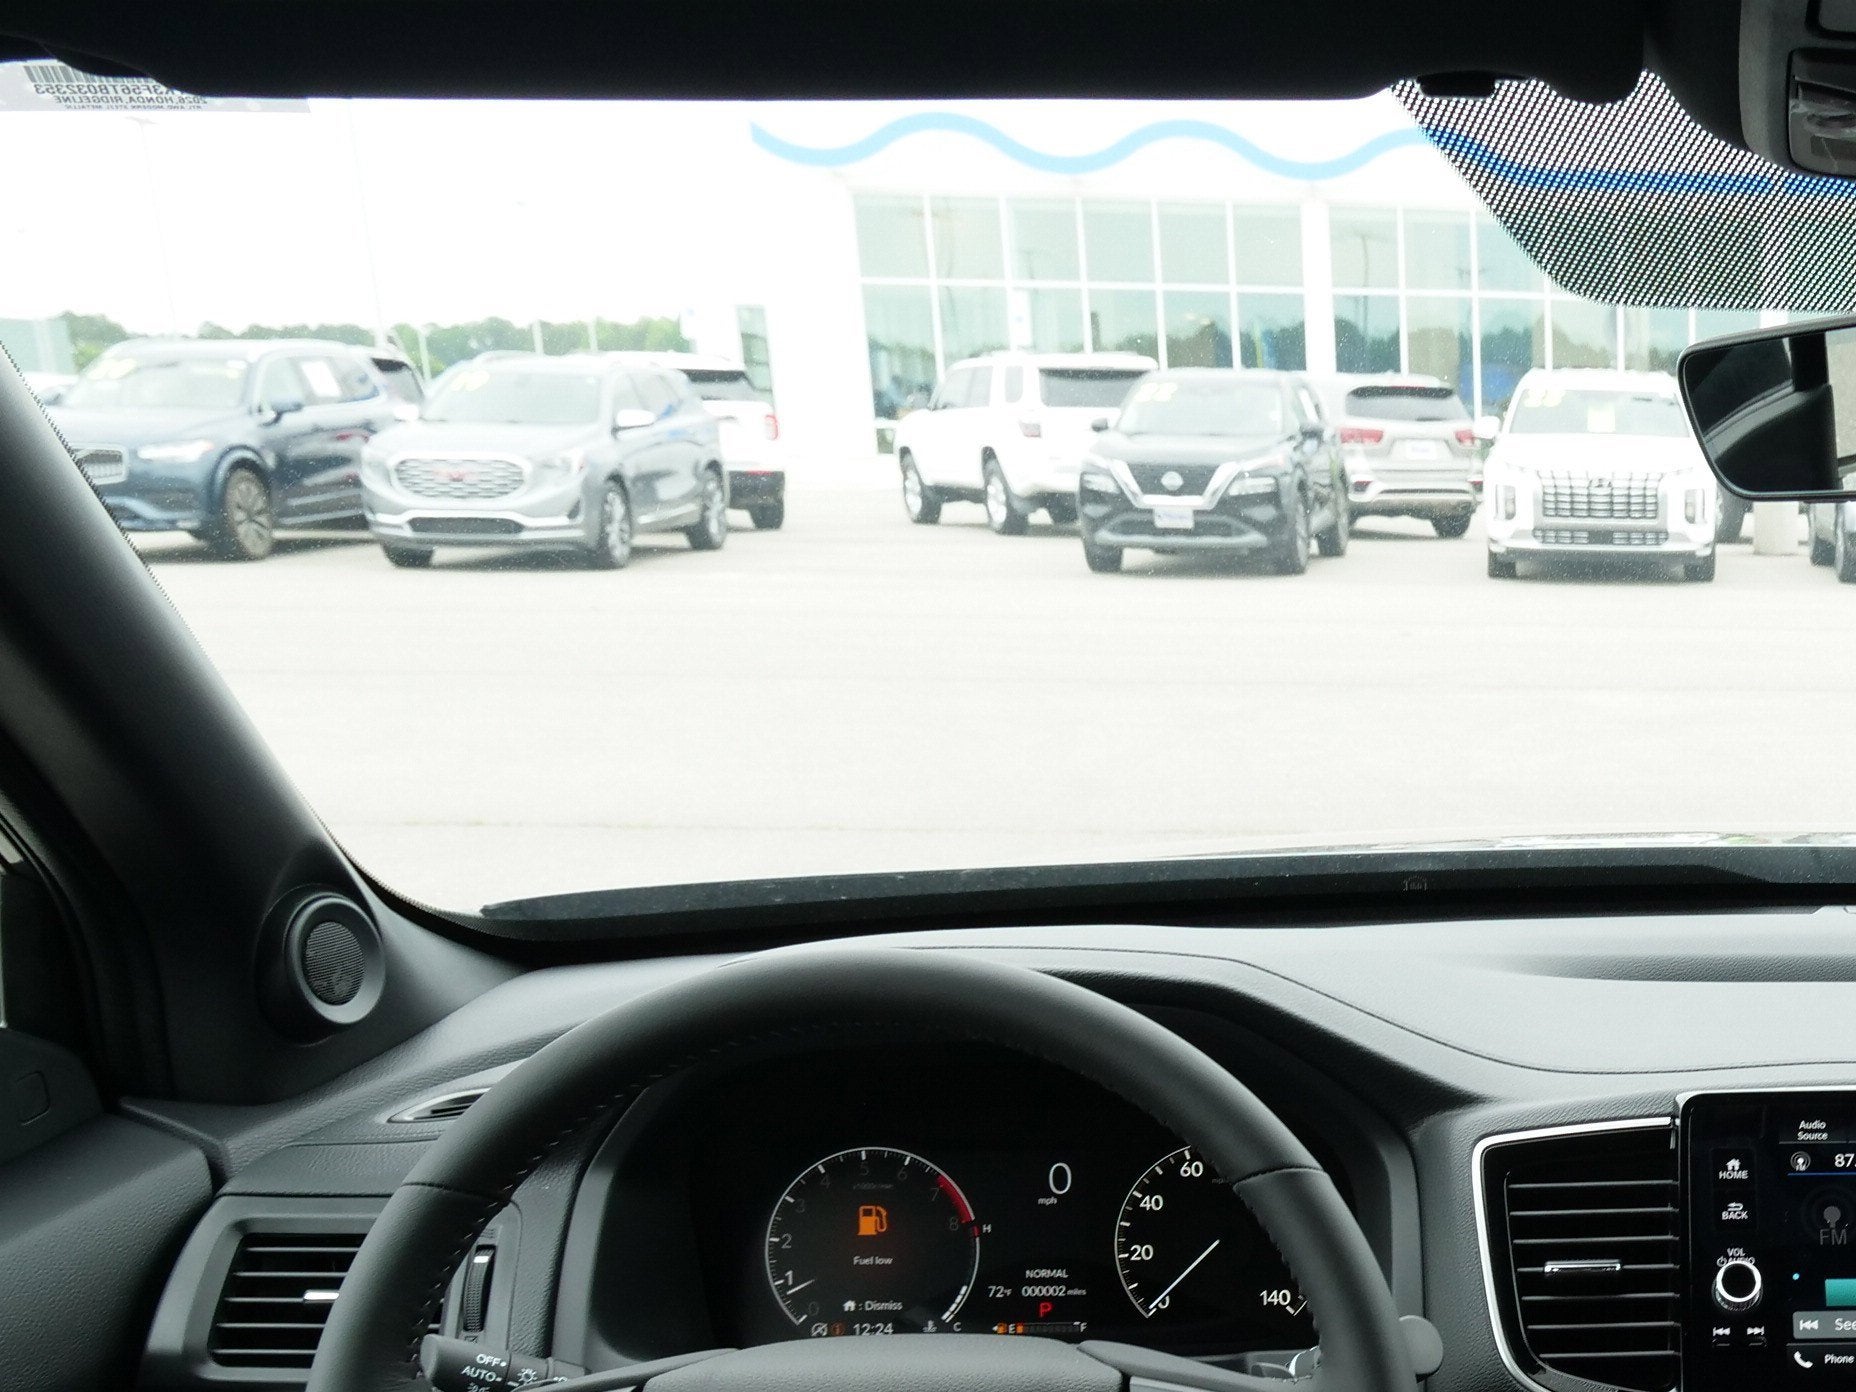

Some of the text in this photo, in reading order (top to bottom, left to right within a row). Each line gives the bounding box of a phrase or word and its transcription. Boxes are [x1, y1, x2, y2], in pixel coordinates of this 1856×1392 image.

[1798, 1119, 1827, 1131] Audio
[1797, 1131, 1829, 1141] Source
[1179, 1161, 1204, 1178] 60
[1718, 1170, 1749, 1180] HOME
[1048, 1162, 1072, 1195] 0
[1037, 1197, 1058, 1207] mph
[1139, 1195, 1164, 1211] 40
[1721, 1211, 1749, 1221] BACK
[981, 1224, 993, 1234] H
[781, 1233, 793, 1249] 2
[1818, 1229, 1848, 1246] FM
[1129, 1244, 1154, 1261] 20
[1727, 1247, 1746, 1257] VOL
[853, 1255, 894, 1266] Fuel low
[784, 1269, 795, 1286] 1
[1025, 1269, 1069, 1279] NORMAL
[1021, 1285, 1067, 1298] 000002
[1259, 1289, 1292, 1307] 140
[864, 1300, 903, 1312] Dismiss
[1038, 1300, 1054, 1319] P
[853, 1322, 895, 1336] 12:24
[953, 1321, 963, 1333] C
[475, 1352, 501, 1368] OFF
[1824, 1353, 1856, 1365] Phone
[461, 1365, 497, 1382] AUTO
